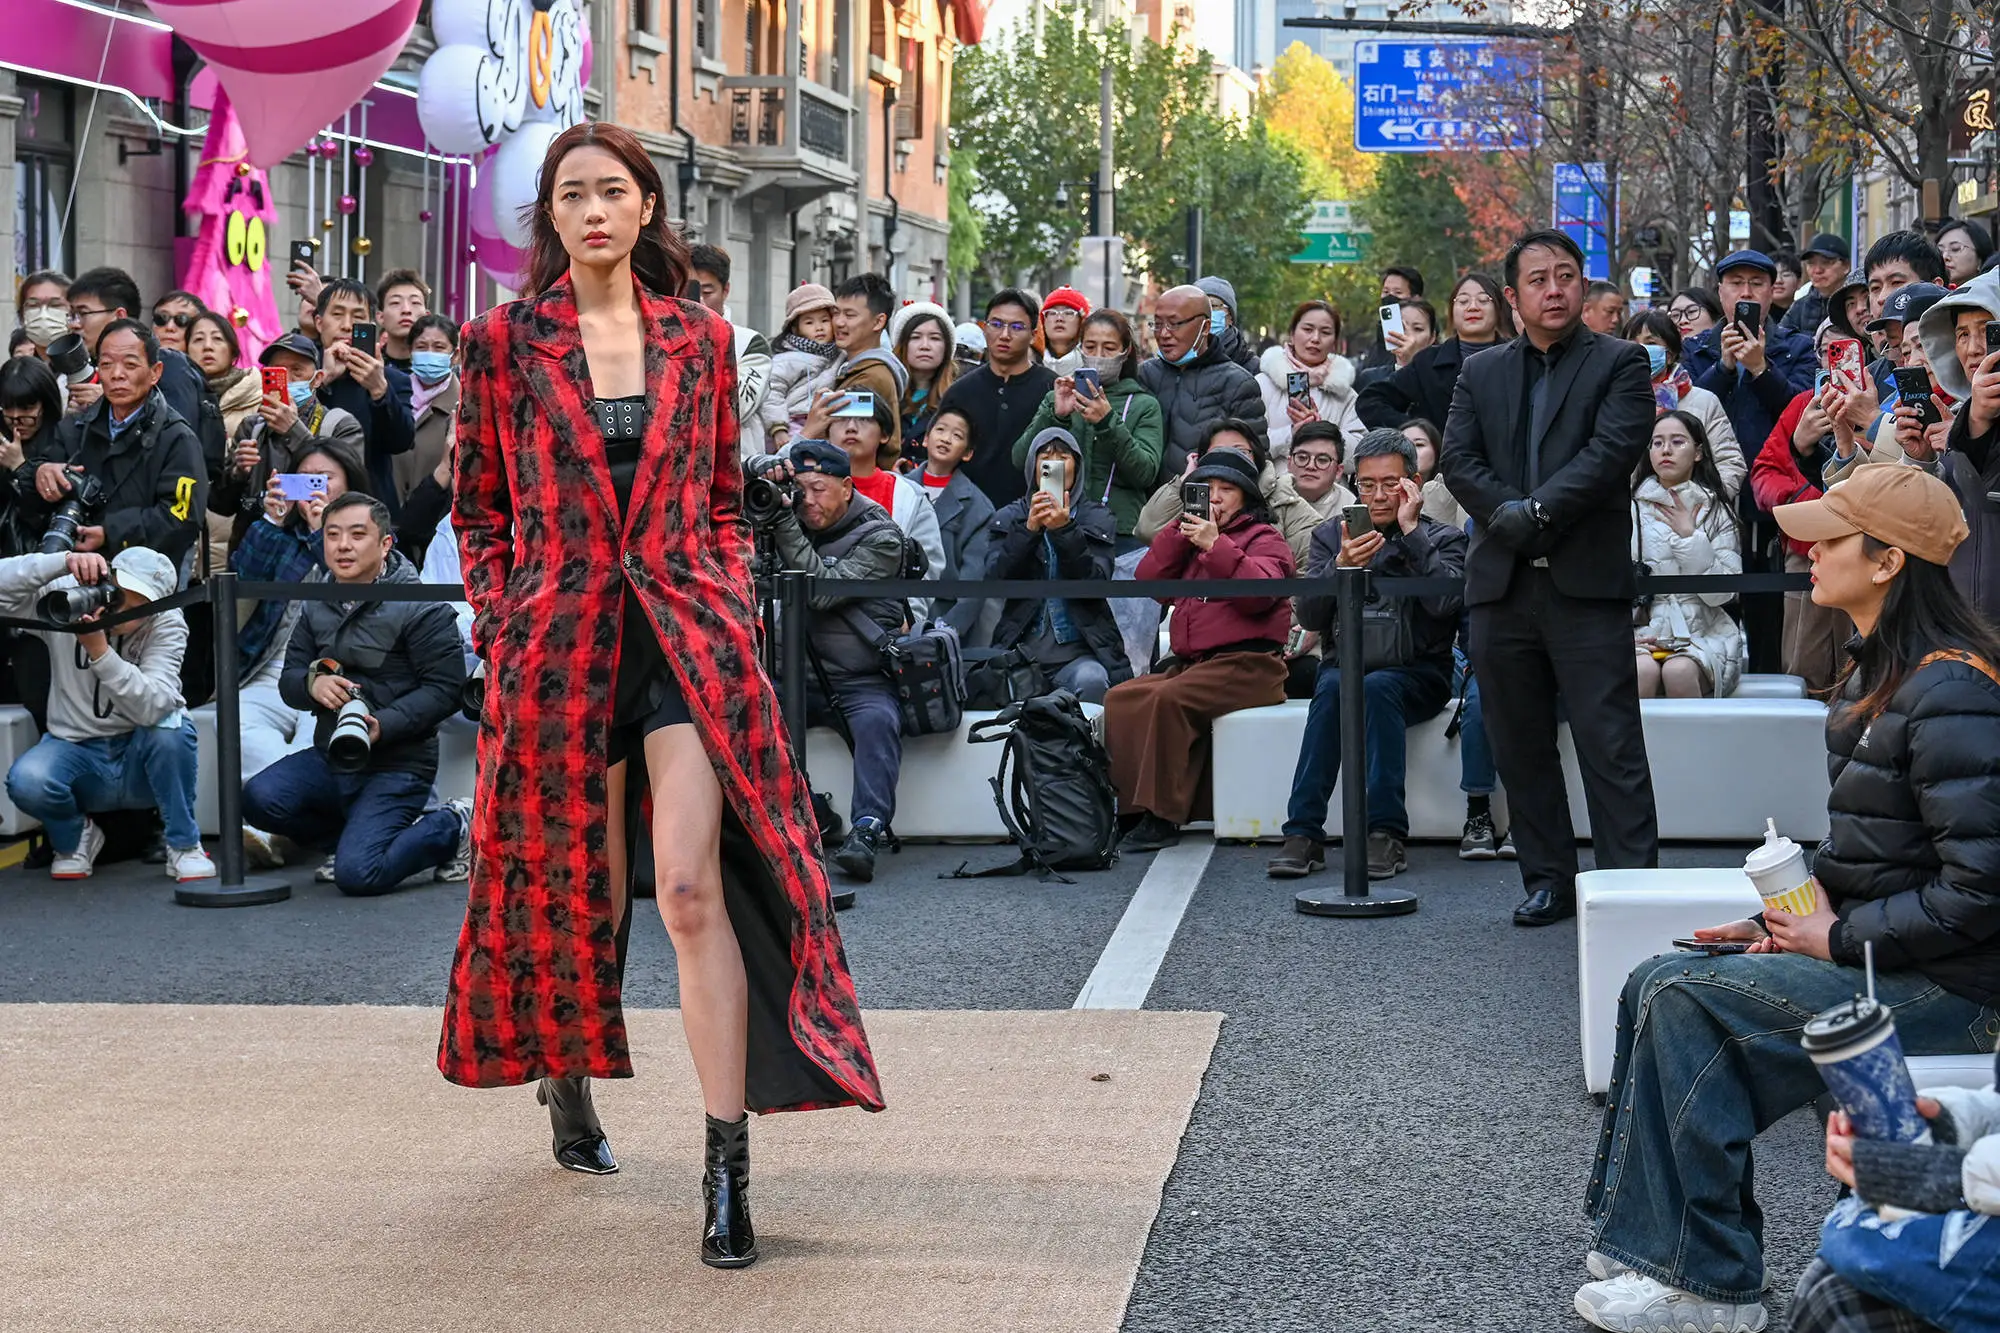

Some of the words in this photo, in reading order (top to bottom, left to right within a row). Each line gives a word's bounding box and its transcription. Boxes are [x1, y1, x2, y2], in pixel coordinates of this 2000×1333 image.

[1362, 83, 1434, 103] 石门一路
[1328, 235, 1358, 249] 入口
